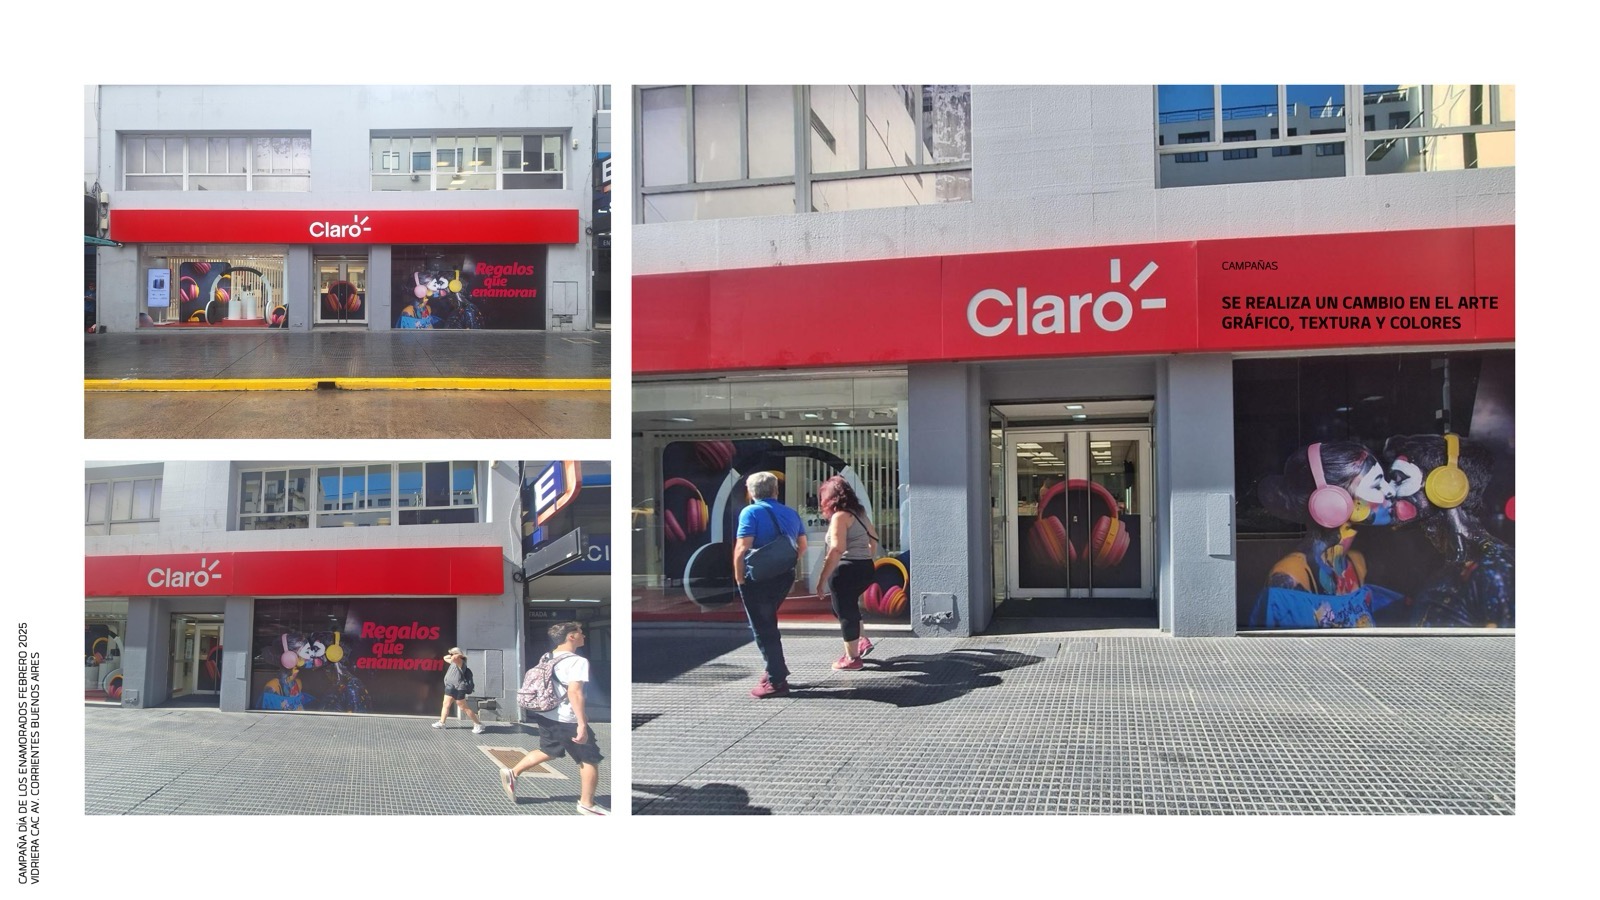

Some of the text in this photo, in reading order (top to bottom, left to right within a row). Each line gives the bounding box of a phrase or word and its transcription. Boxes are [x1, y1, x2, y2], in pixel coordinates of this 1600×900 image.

[309, 221, 362, 238] Claro
[475, 261, 534, 278] Regalos
[483, 275, 508, 289] que
[471, 287, 537, 298] enamoran
[966, 287, 1133, 337] Claro
[534, 464, 557, 513] E
[147, 567, 210, 588] Claro
[361, 621, 441, 643] Regalos
[371, 641, 405, 658] que
[356, 656, 445, 672] enamoran
